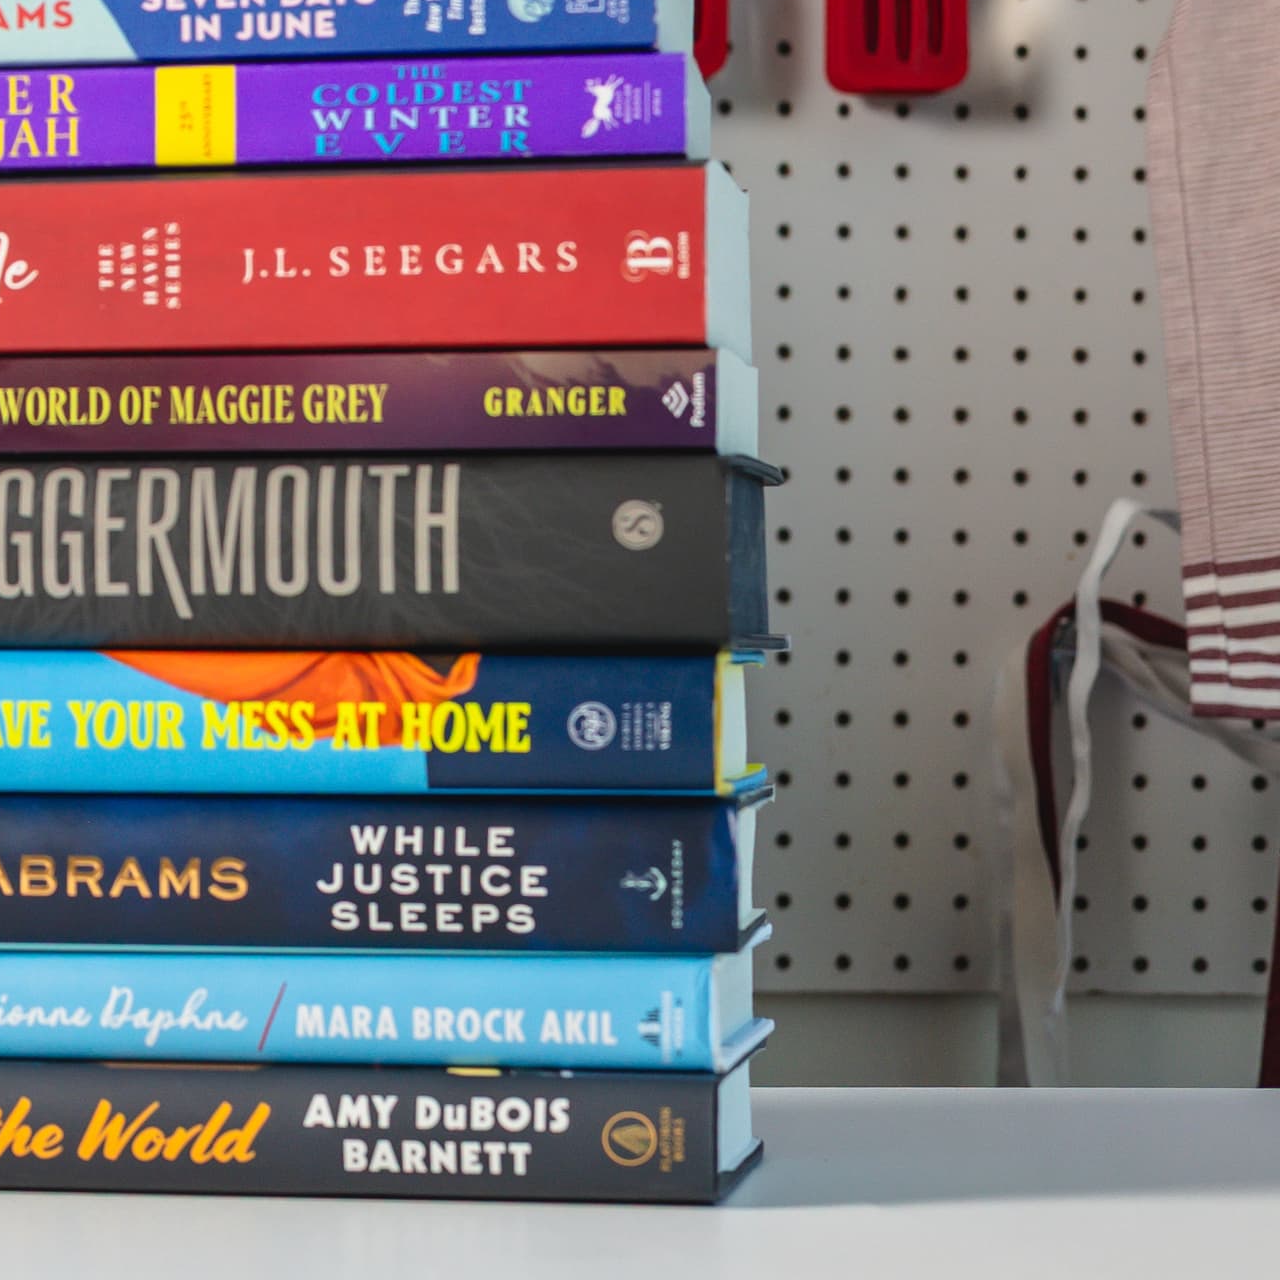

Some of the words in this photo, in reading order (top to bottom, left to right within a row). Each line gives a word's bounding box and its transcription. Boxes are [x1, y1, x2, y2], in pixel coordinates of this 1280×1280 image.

[180, 14, 222, 43] IN
[236, 11, 337, 41] JUNE
[425, 4, 442, 33] New
[393, 65, 446, 79] THE
[311, 80, 533, 106] COLDEST
[312, 106, 531, 131] WINTER
[313, 131, 531, 157] EVER
[98, 243, 115, 291] THE
[120, 242, 137, 292] NEW
[141, 227, 159, 306] HAVEN
[164, 222, 181, 310] SERIES
[242, 247, 311, 285] J.L.
[330, 241, 579, 277] SEEGARS
[119, 386, 161, 424] OF
[168, 385, 294, 424] MAGGIE
[302, 383, 389, 424] GREY
[484, 387, 627, 417] GRANGER
[690, 372, 705, 428] Podium
[67, 700, 185, 749] YOUR
[201, 701, 315, 753] MESS
[333, 702, 392, 750] AT
[403, 701, 531, 754] HOME
[351, 825, 515, 857] WHILE
[317, 864, 549, 896] JUSTICE
[331, 902, 536, 934] SLEEPS
[102, 985, 248, 1047] Daphne
[296, 1004, 397, 1039] MARA
[412, 1007, 526, 1043] BROCK
[541, 1011, 618, 1046] AKIL
[76, 1099, 271, 1165] World
[303, 1094, 398, 1129] AMY
[416, 1096, 570, 1133] DuBOIS
[343, 1140, 532, 1175] BARNETT
